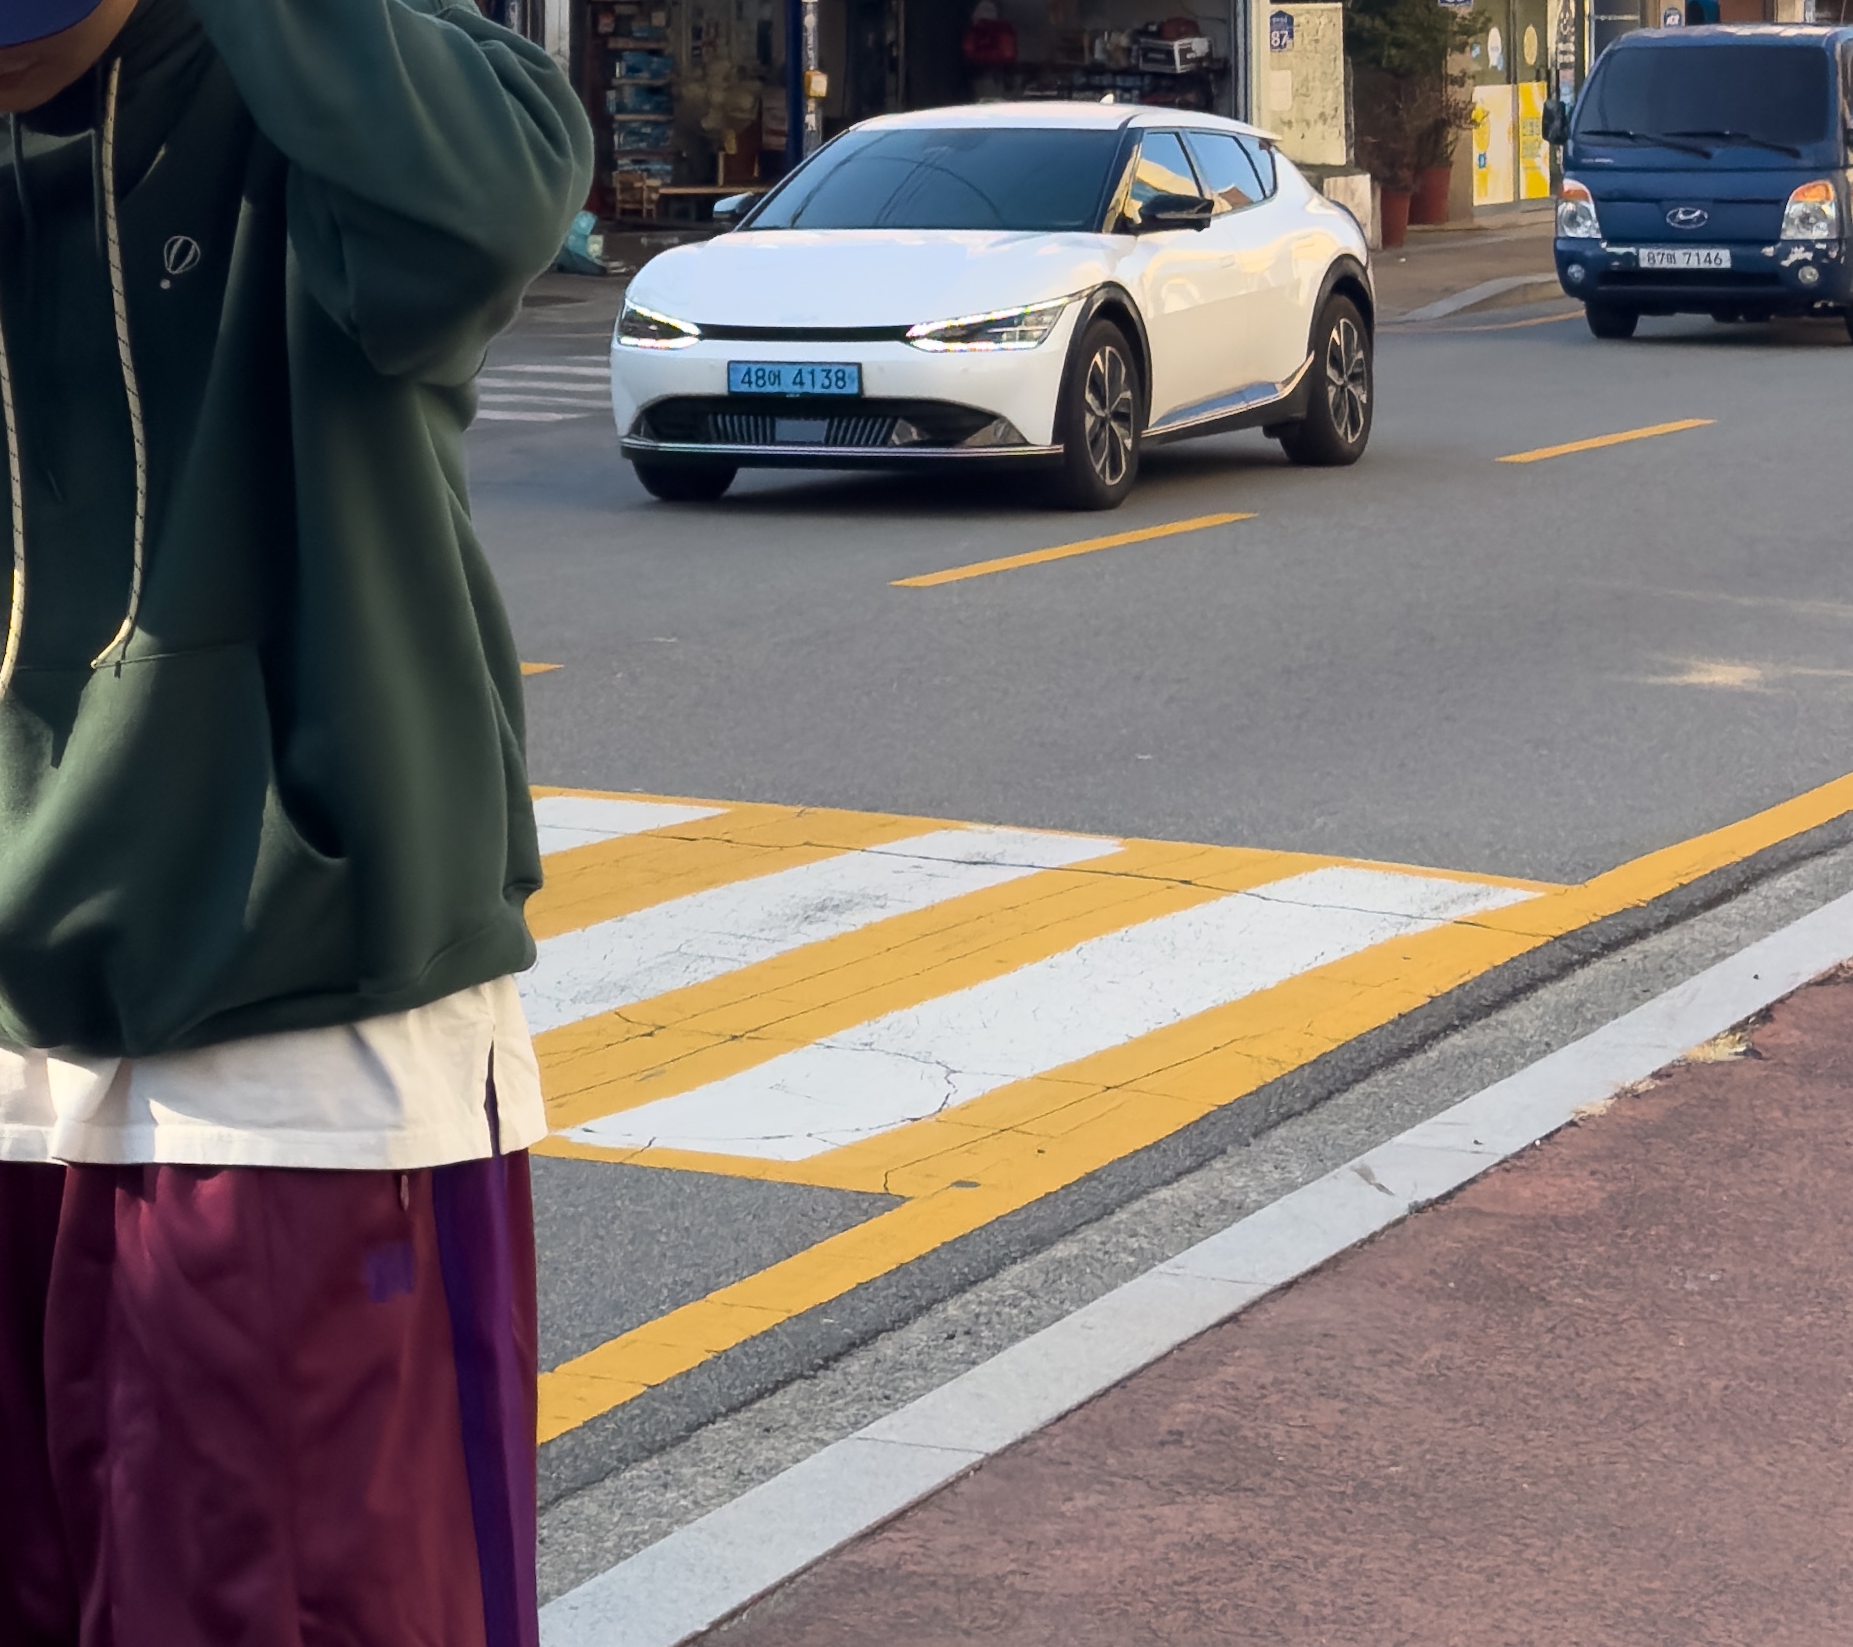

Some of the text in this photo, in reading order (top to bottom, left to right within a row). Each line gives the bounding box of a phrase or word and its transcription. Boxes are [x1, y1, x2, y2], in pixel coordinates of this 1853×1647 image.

[1270, 30, 1288, 47] 87
[1683, 251, 1723, 266] 7146
[791, 368, 847, 390] 4138
